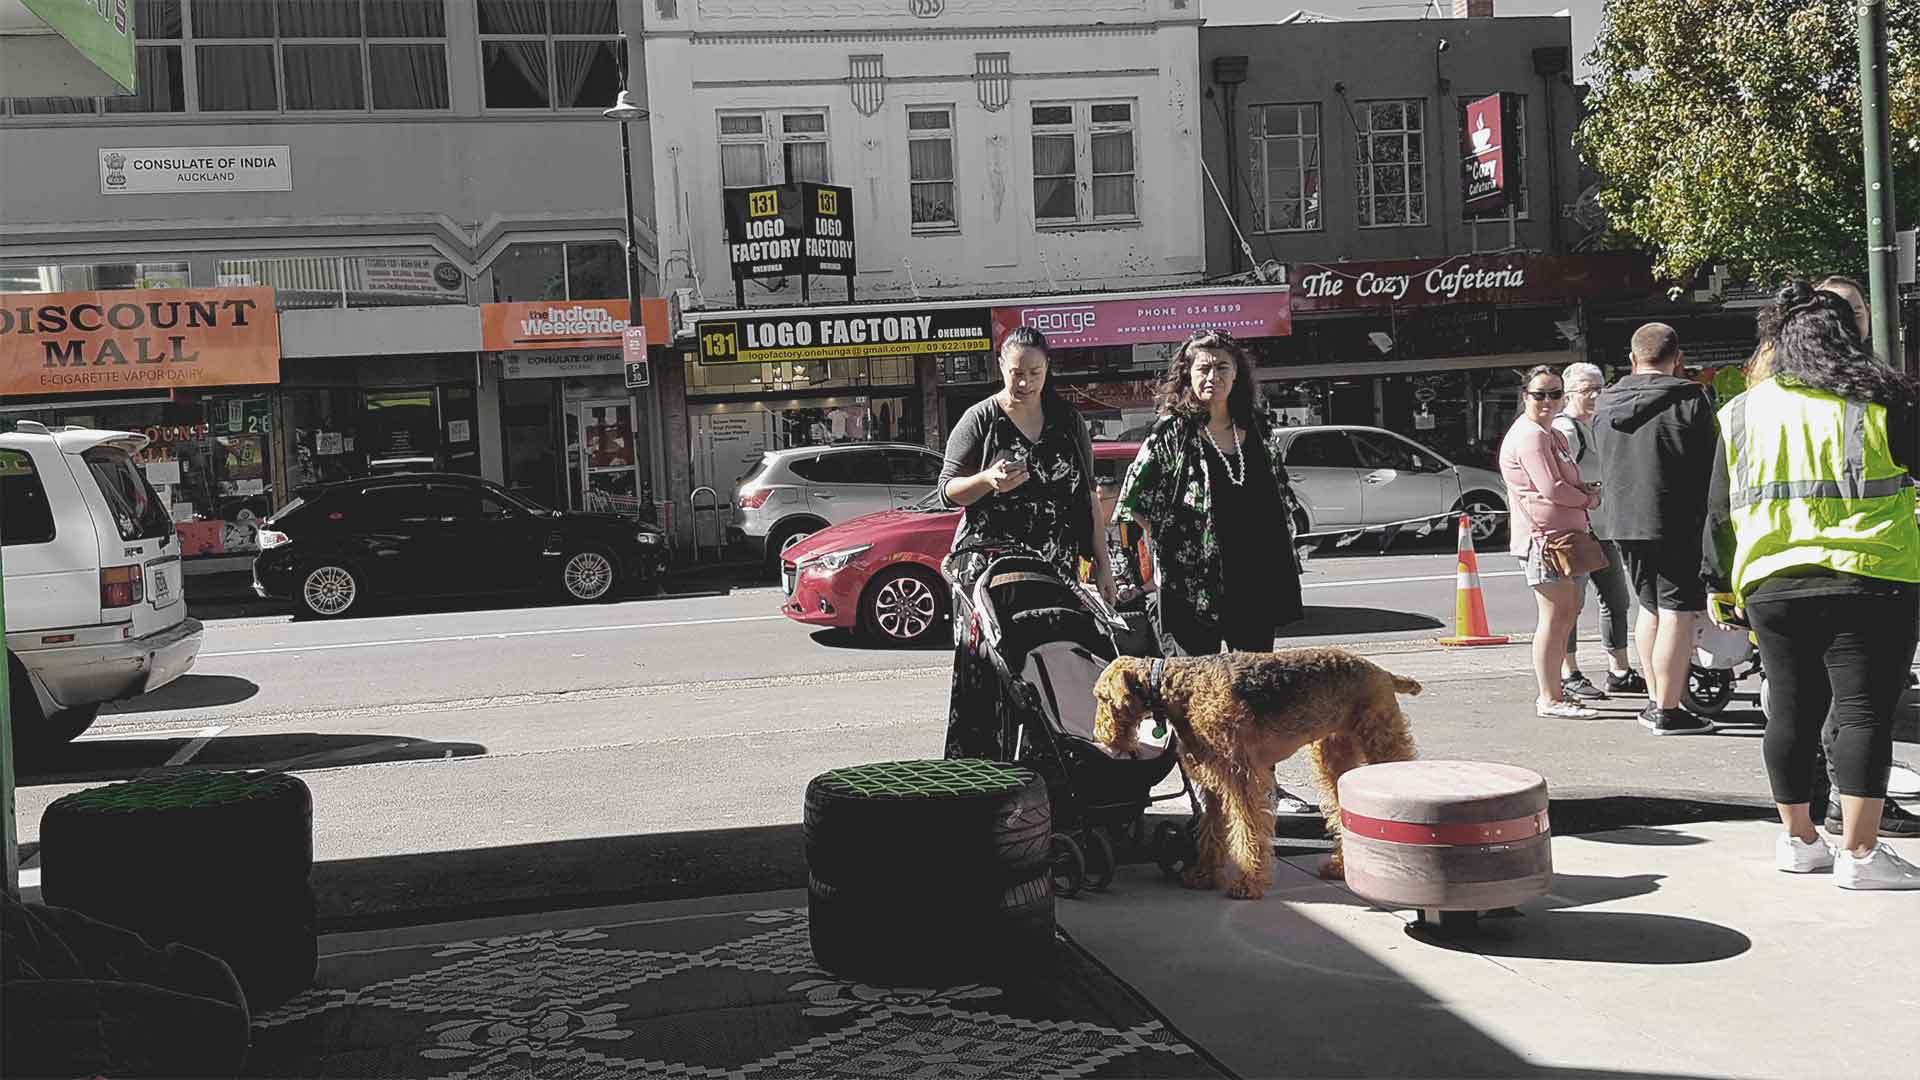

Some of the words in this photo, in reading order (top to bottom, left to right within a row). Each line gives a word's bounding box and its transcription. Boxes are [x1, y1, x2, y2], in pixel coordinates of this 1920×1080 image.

[133, 158, 214, 170] CONSULATE
[217, 158, 236, 169] OF
[240, 157, 277, 168] INDIA
[1472, 160, 1497, 180] Cozy
[177, 172, 235, 182] AUCKLAND
[751, 194, 776, 214] 131
[819, 193, 836, 211] 131
[745, 218, 785, 239] LOGO
[815, 217, 843, 237] LOGO
[731, 239, 801, 263] FACTORY
[805, 238, 853, 259] FACTORY
[1302, 271, 1344, 298] The
[1356, 272, 1410, 300] Cozy
[1425, 264, 1525, 298] Cafeteria
[528, 310, 549, 320] the
[1021, 305, 1097, 335] George
[1137, 307, 1177, 317] PHONE
[1187, 306, 1208, 315] 634
[703, 333, 736, 356] 131
[746, 320, 812, 348] LOGO
[820, 315, 932, 344] FACTORY
[41, 336, 201, 368] MALL
[40, 371, 120, 386] E-CIGARETTE
[123, 369, 165, 383] VAPOR
[632, 363, 640, 373] P
